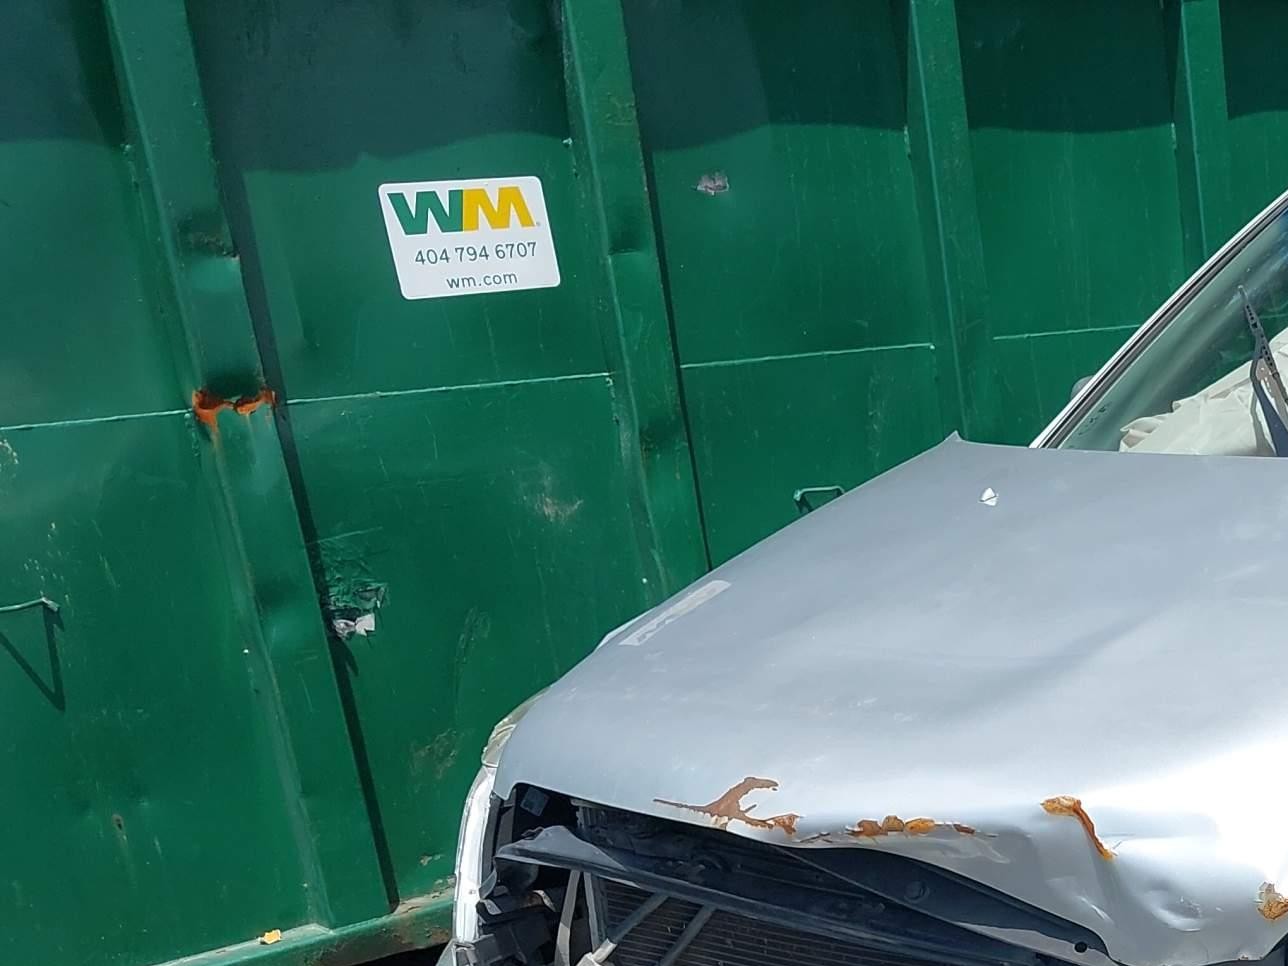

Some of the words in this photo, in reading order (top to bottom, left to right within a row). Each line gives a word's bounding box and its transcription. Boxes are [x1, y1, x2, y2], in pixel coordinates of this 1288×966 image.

[387, 186, 535, 236] WM
[414, 247, 450, 265] 404
[454, 245, 489, 262] 794
[495, 241, 537, 259] 6707
[446, 271, 518, 289] wm.com
